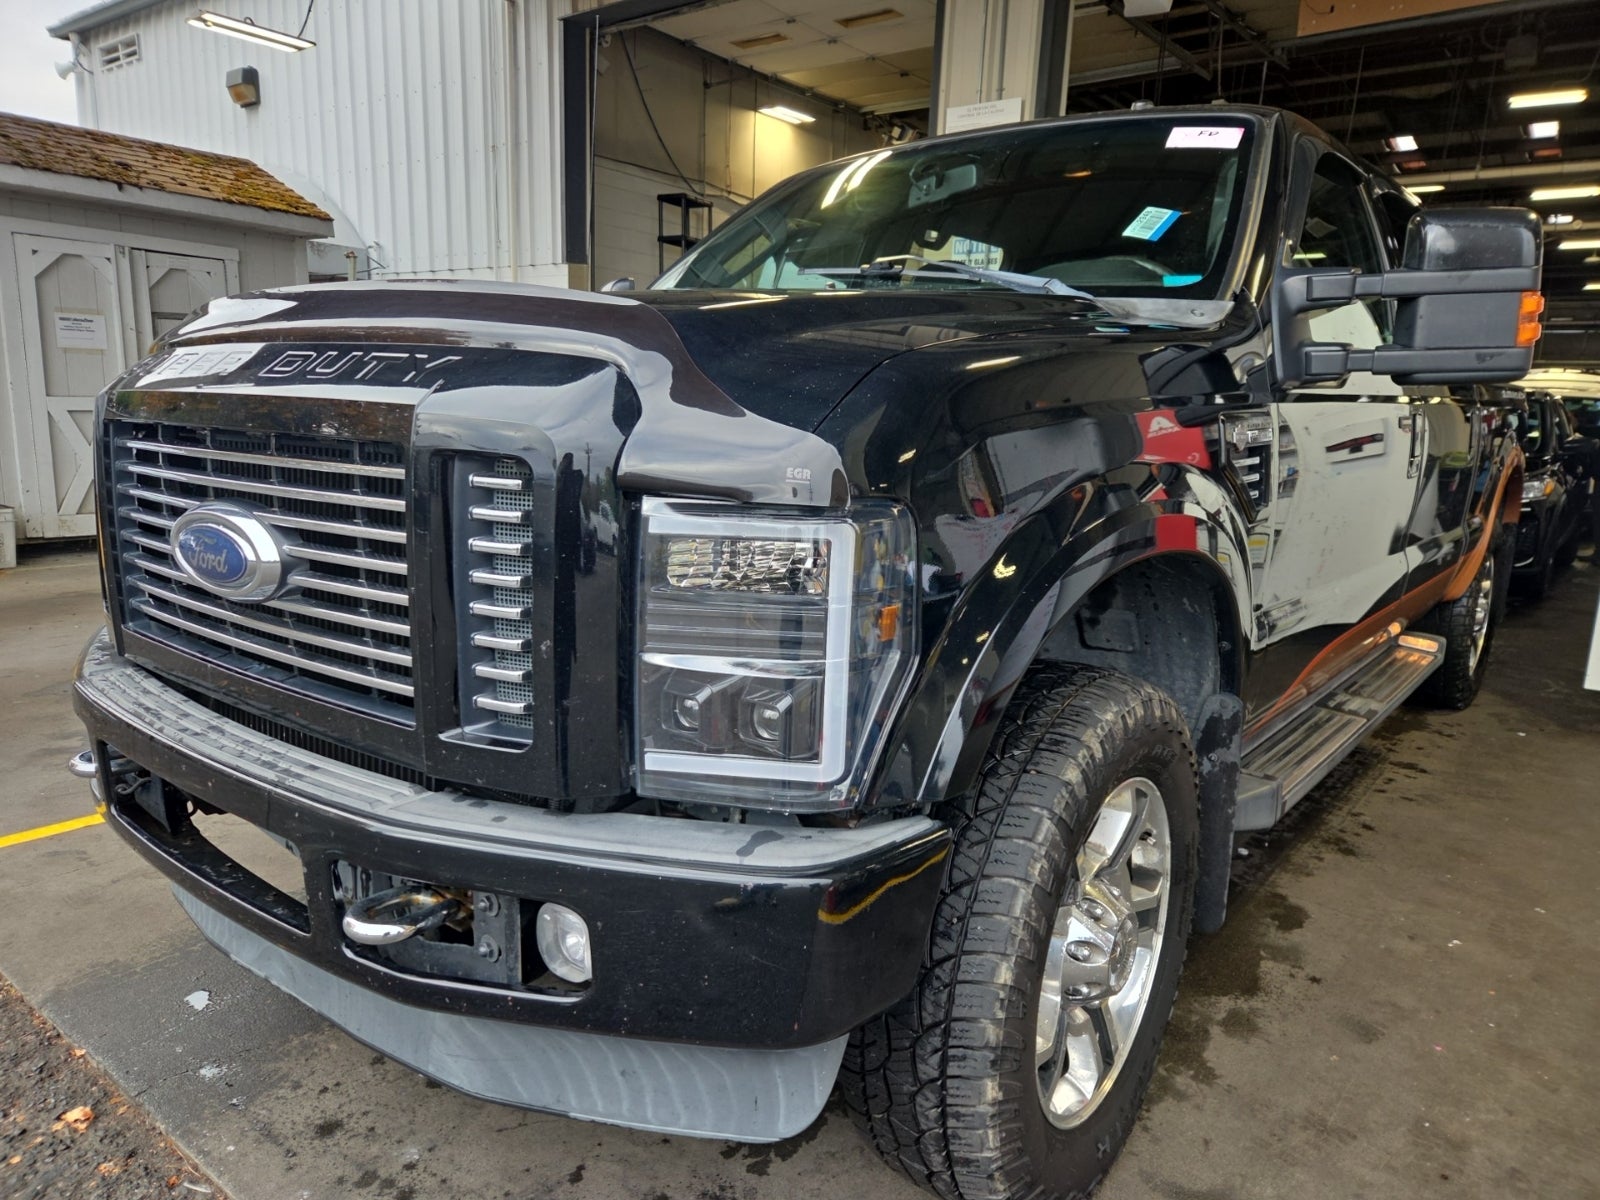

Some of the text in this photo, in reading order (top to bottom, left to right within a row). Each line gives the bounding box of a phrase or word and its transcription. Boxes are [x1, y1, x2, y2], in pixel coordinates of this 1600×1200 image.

[257, 350, 463, 383] DUTY
[786, 467, 812, 480] EGR
[188, 538, 228, 574] Ford
